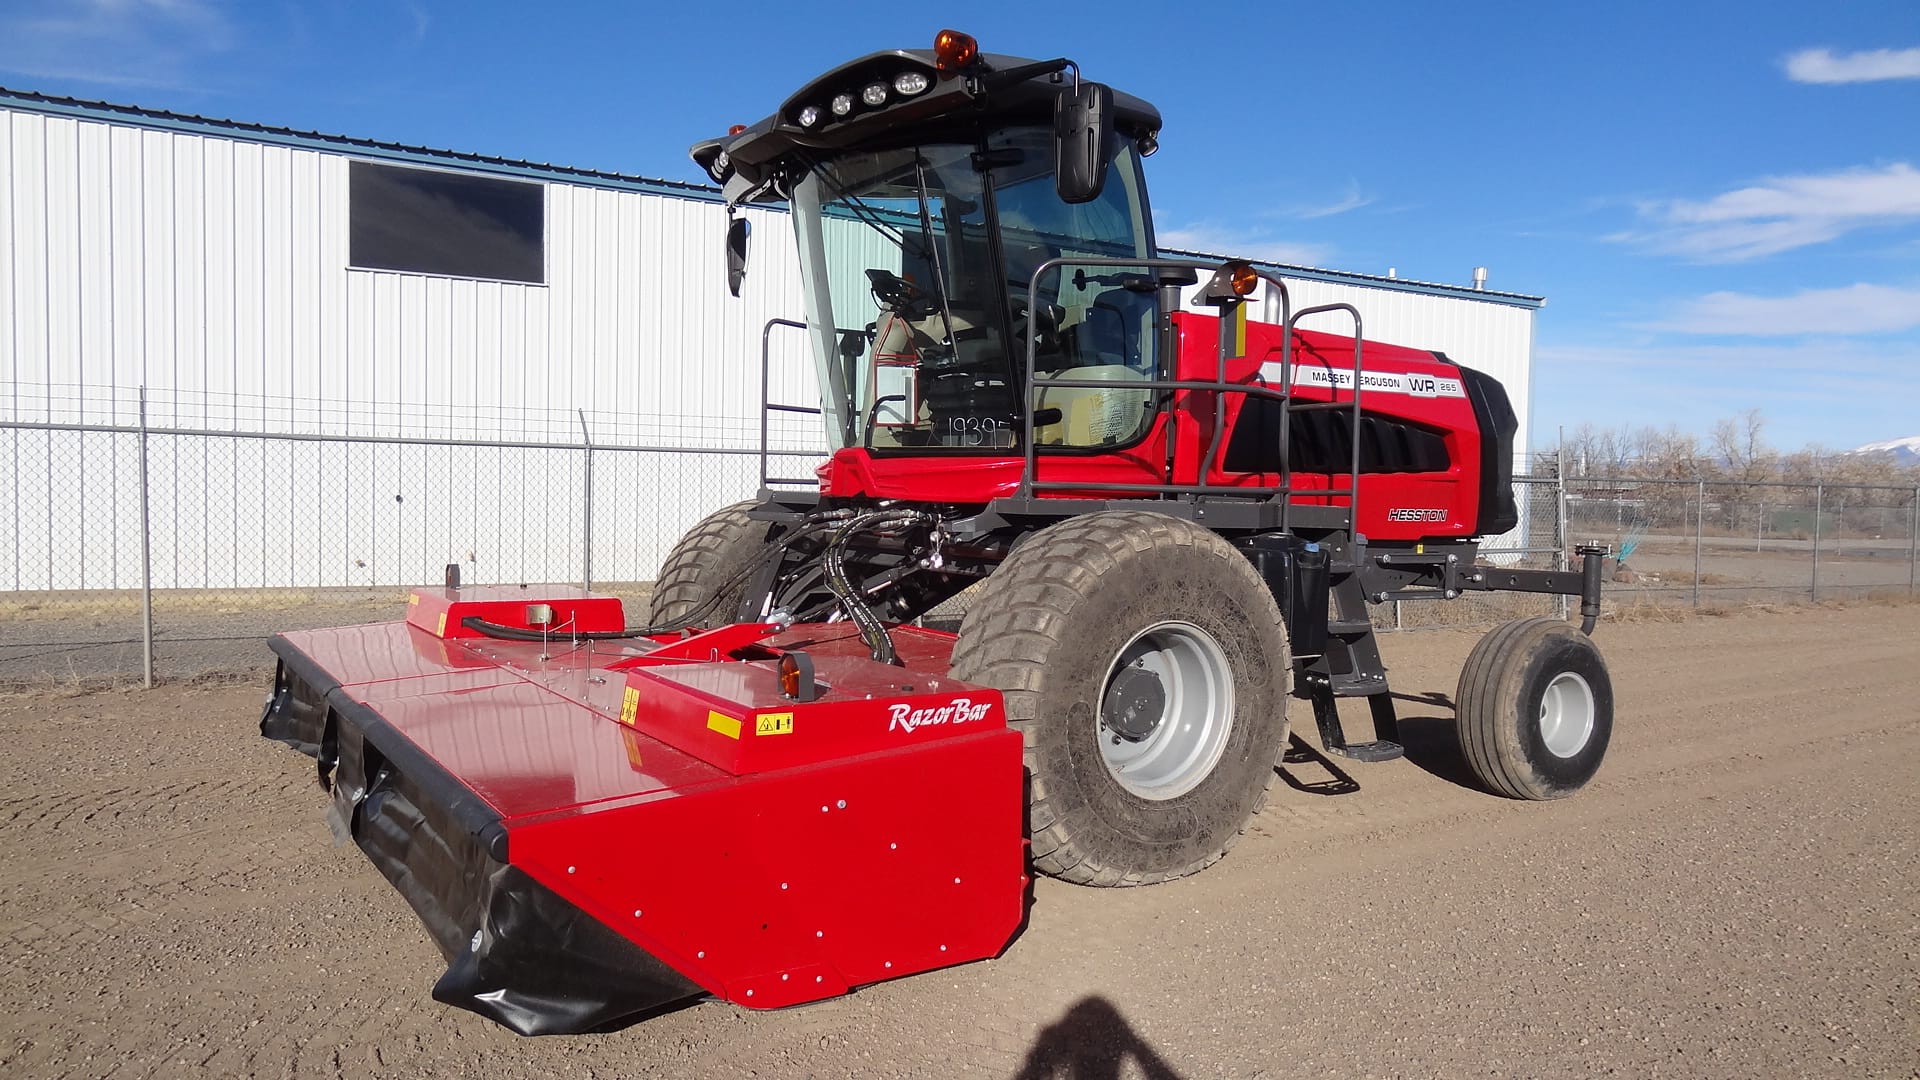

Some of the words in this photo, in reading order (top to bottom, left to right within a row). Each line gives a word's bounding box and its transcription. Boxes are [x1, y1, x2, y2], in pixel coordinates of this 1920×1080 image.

[1312, 371, 1351, 384] MASSEY
[1356, 375, 1400, 389] ERGUSON
[1408, 378, 1436, 393] WR
[1440, 383, 1457, 392] 265
[1387, 508, 1448, 522] HESSTON
[888, 698, 992, 734] RazorBar
